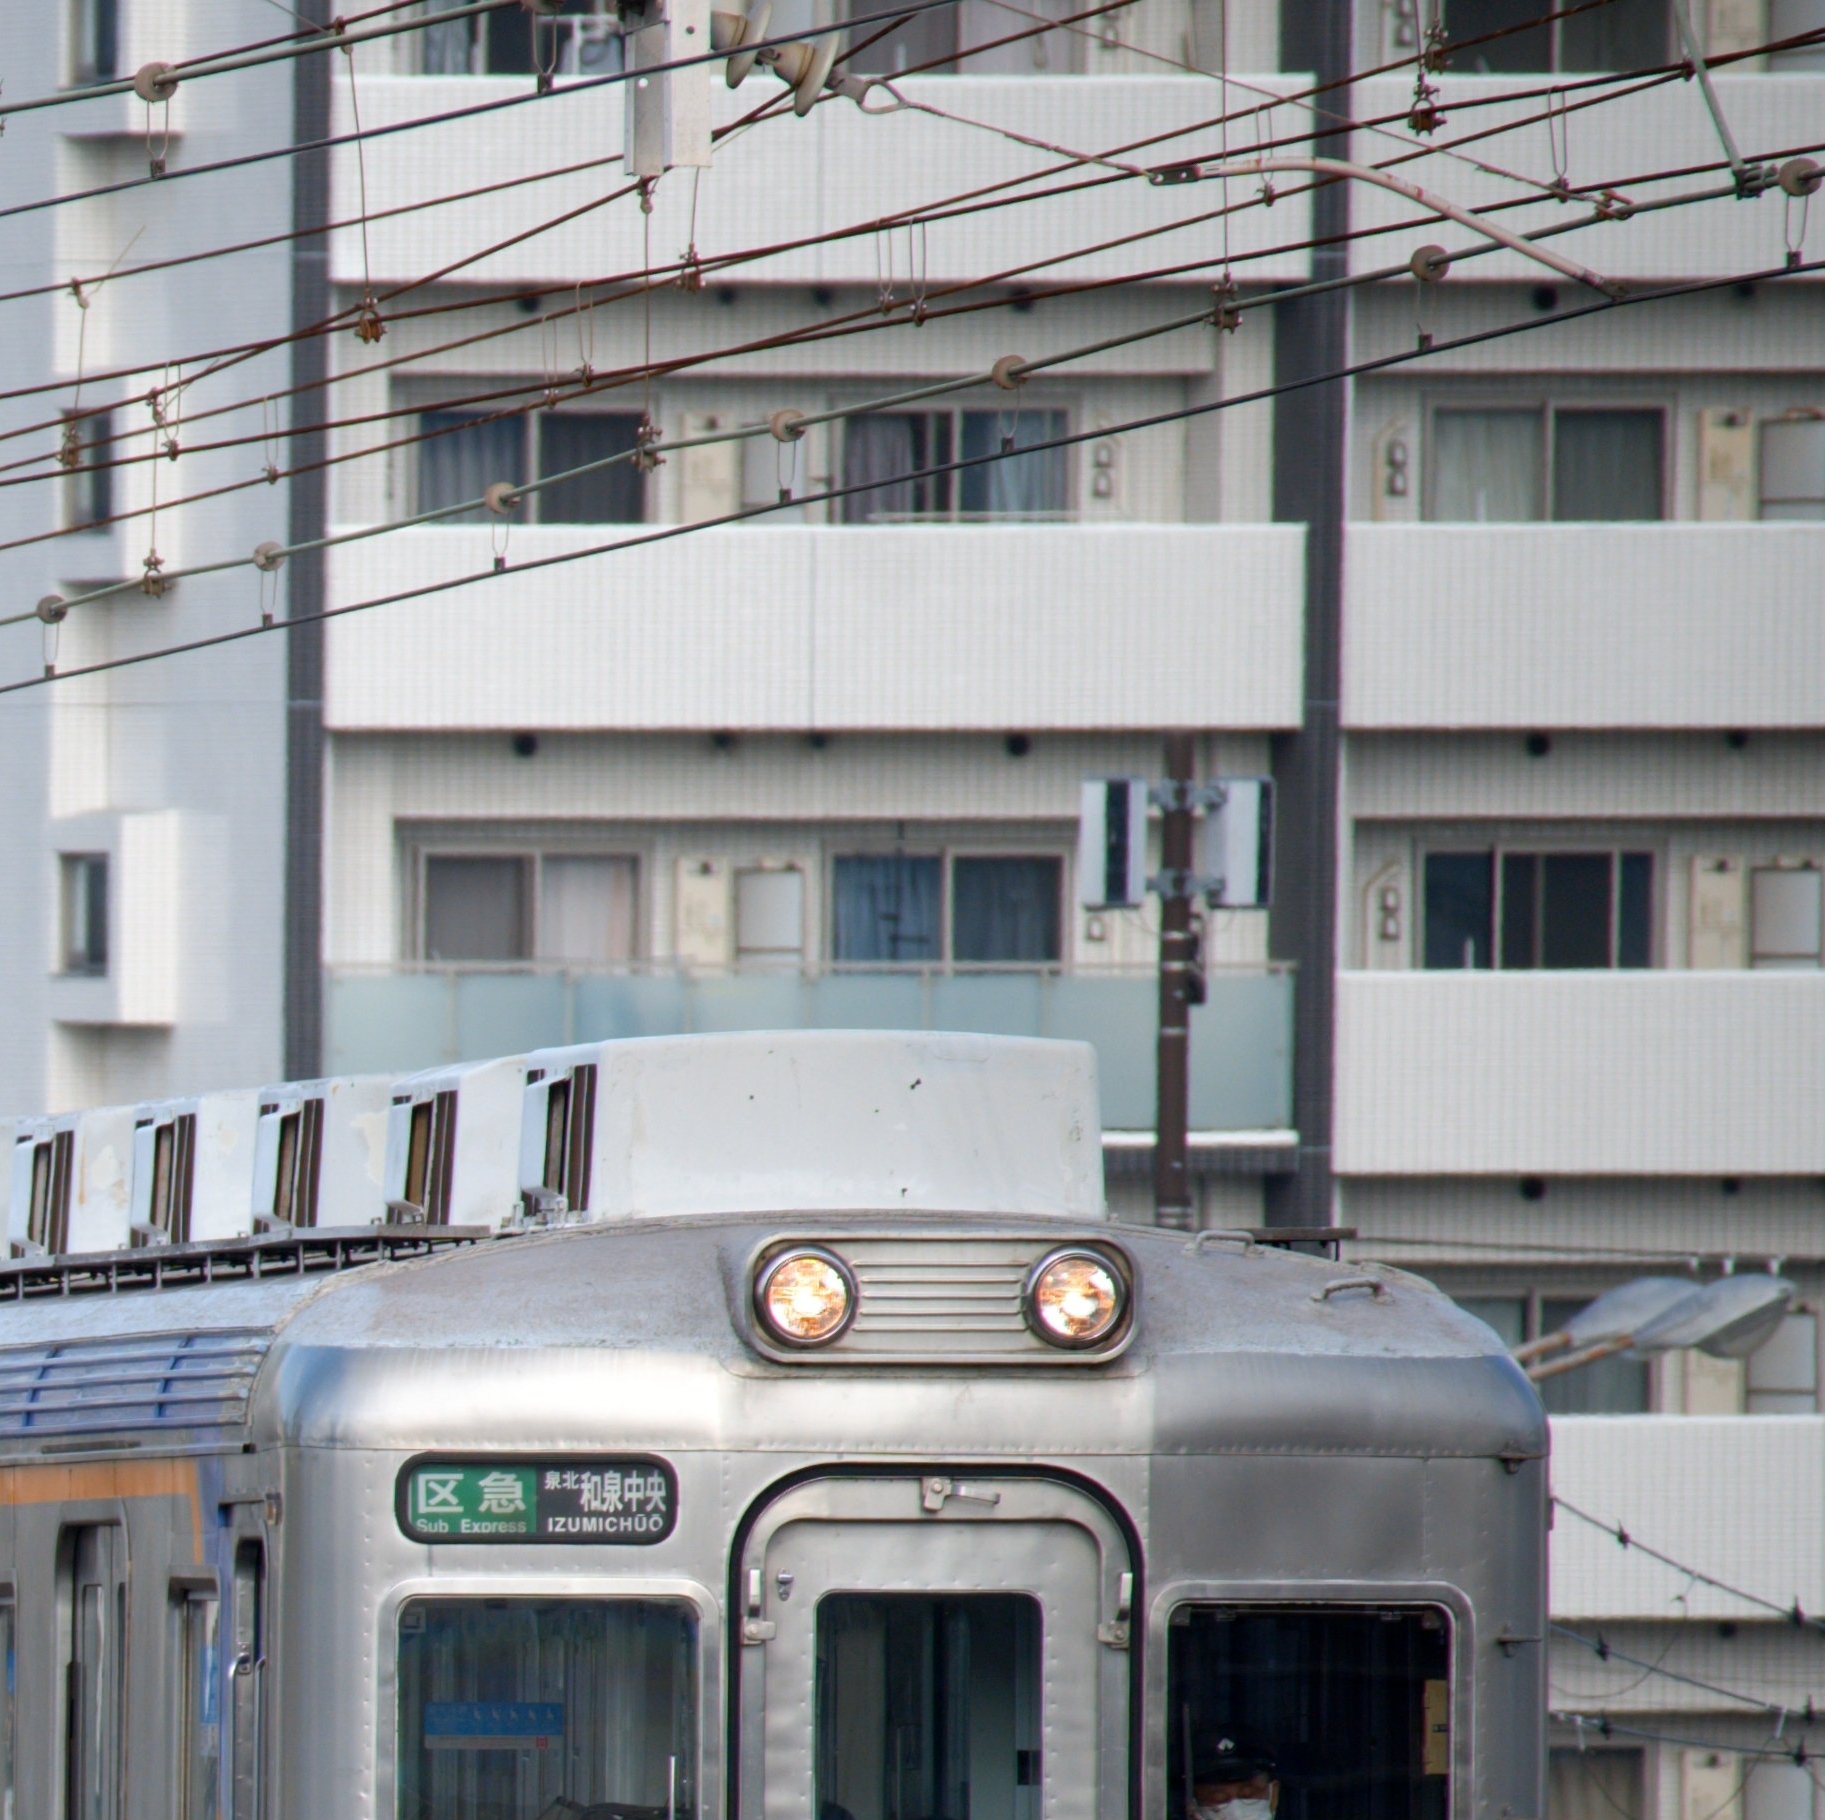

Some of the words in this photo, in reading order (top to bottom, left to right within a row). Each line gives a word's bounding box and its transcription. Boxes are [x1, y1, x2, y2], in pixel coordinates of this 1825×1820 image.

[417, 1472, 527, 1514] 区急
[416, 1518, 449, 1533] Sub
[461, 1518, 527, 1533] Express
[548, 1514, 664, 1533] IZUMICHŪŌ
